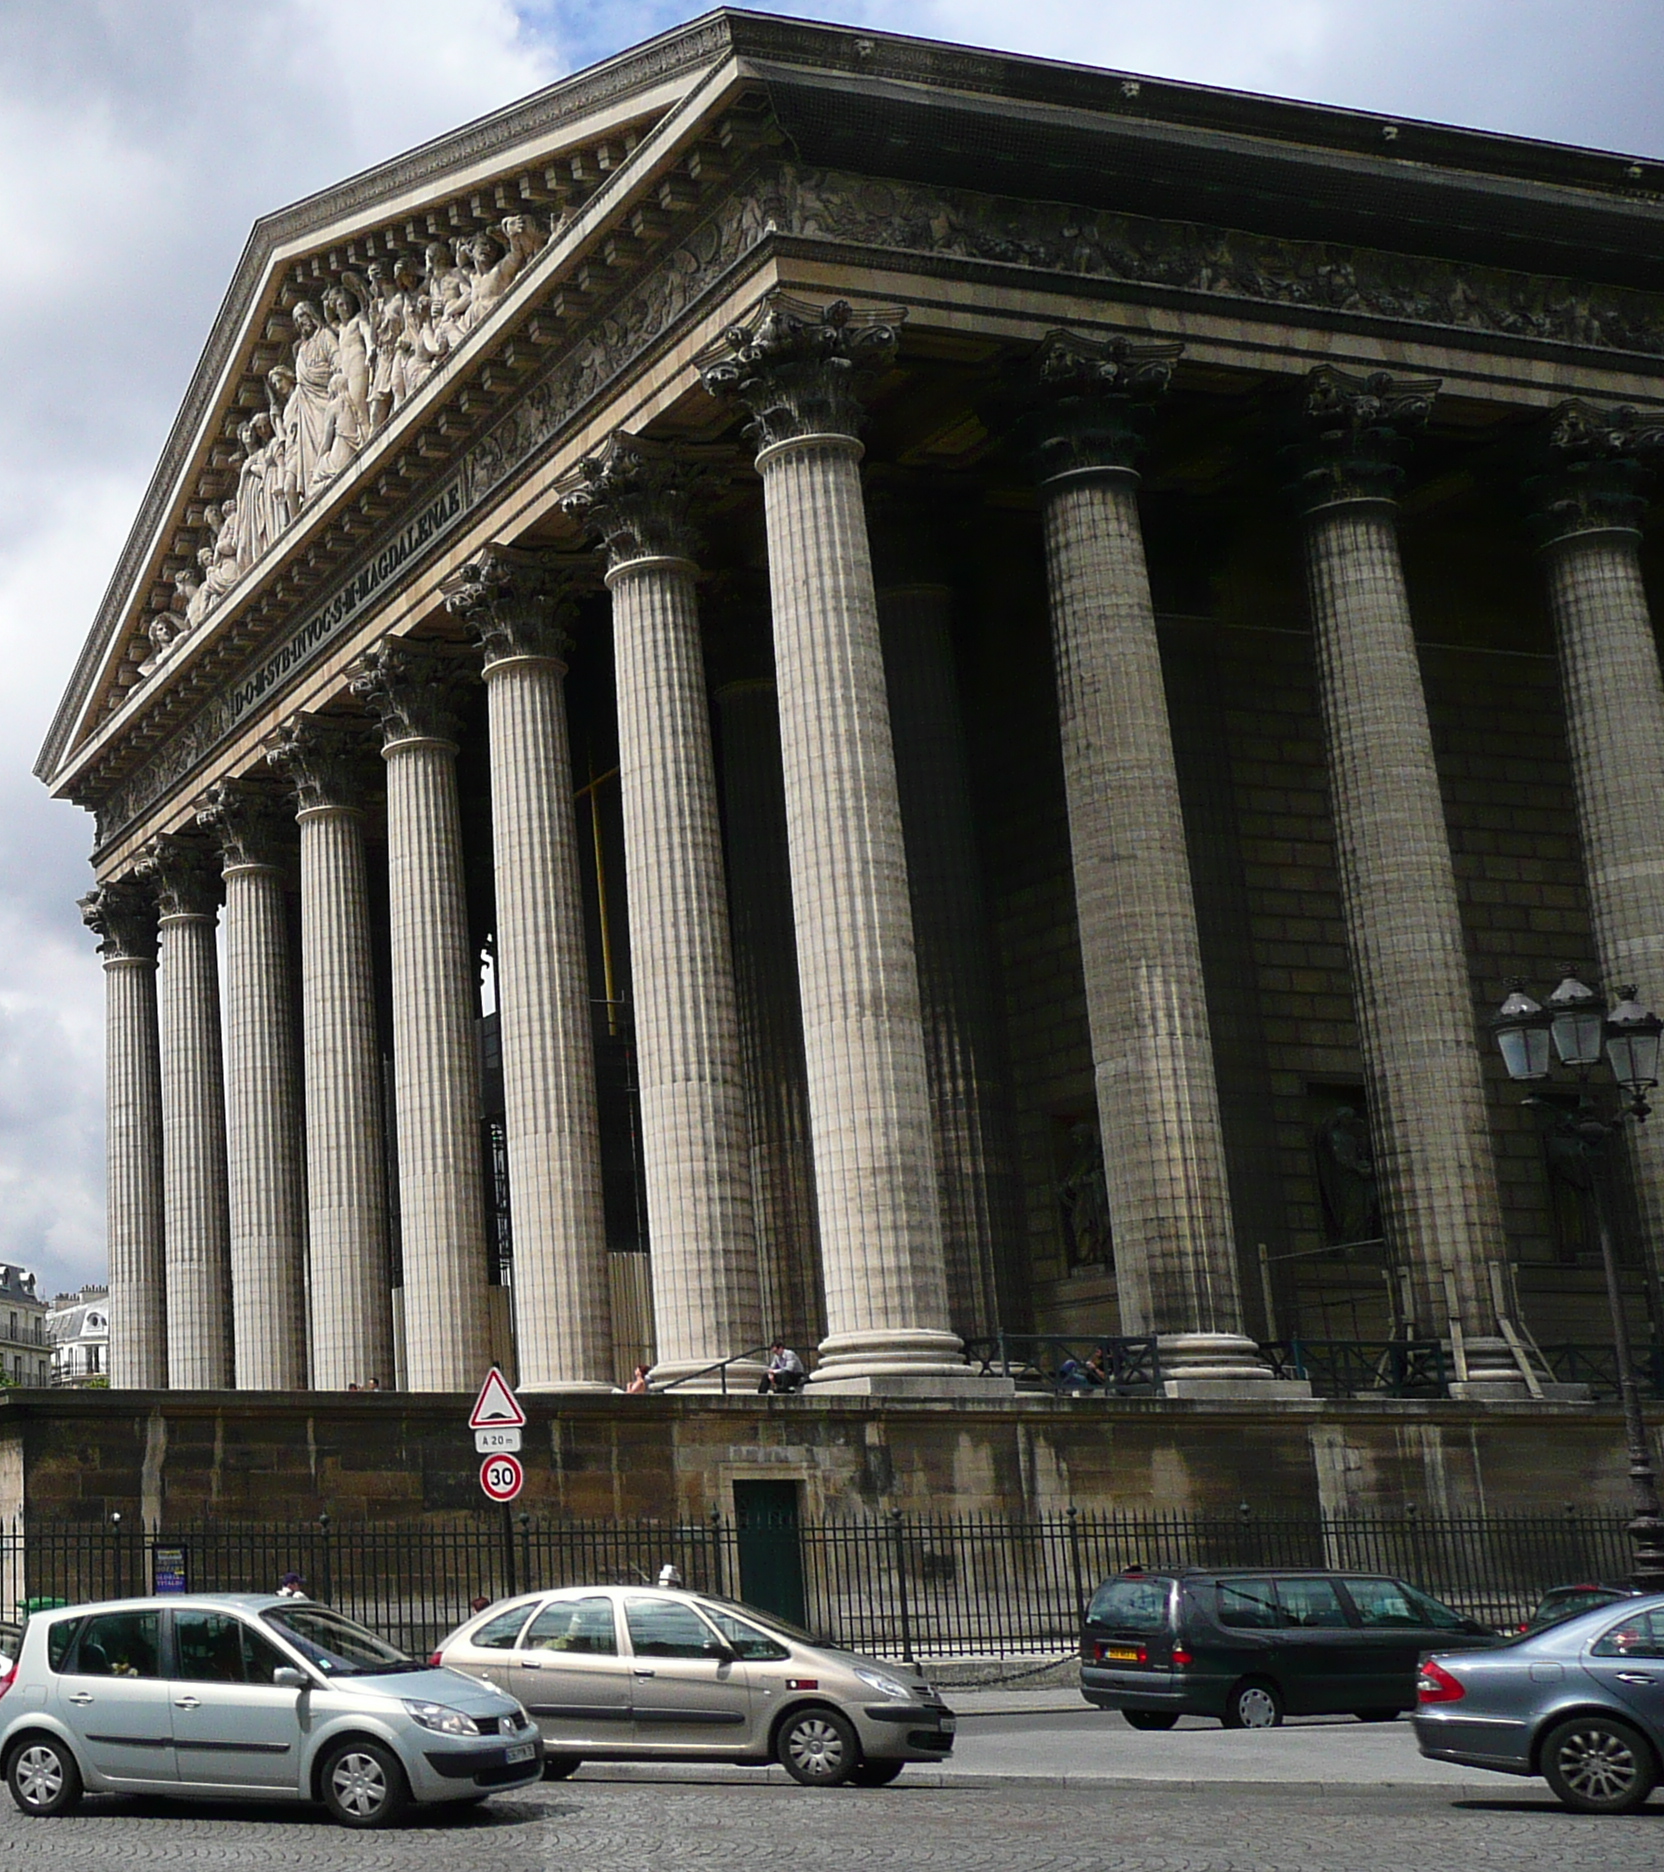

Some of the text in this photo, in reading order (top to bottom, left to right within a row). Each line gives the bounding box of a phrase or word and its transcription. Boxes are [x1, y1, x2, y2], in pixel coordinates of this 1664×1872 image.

[483, 1436, 489, 1446] A
[491, 1436, 504, 1446] 20
[490, 1467, 513, 1487] 30
